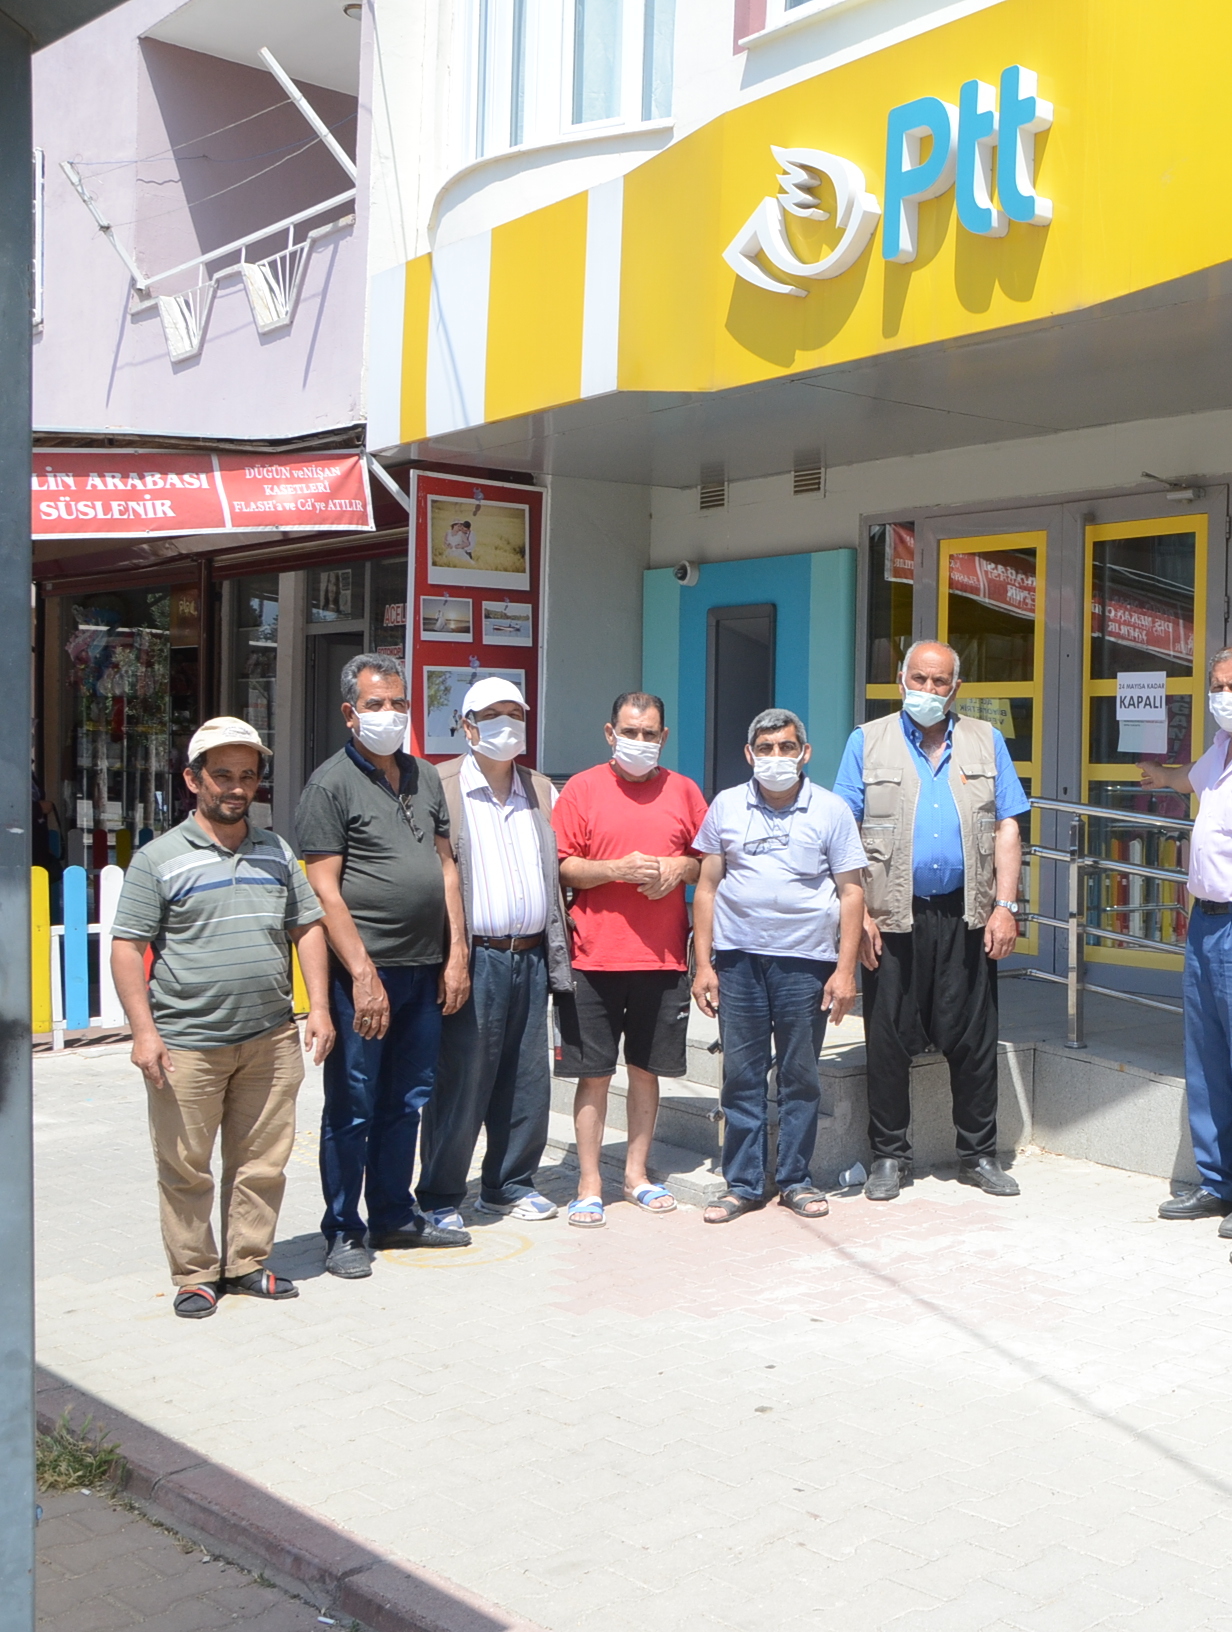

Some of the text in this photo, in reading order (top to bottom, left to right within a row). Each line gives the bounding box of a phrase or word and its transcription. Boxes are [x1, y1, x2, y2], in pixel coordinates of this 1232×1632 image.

[882, 65, 1053, 264] Ptt
[245, 465, 291, 479] DÜĞÜN
[85, 472, 210, 490] ARABASI
[263, 480, 331, 496] KASETLERİ
[39, 494, 176, 520] SÜSLENİR
[284, 502, 296, 511] ve
[297, 498, 326, 513] Cd'ye
[327, 499, 364, 512] ATILIR
[1119, 695, 1163, 709] KAPALI
